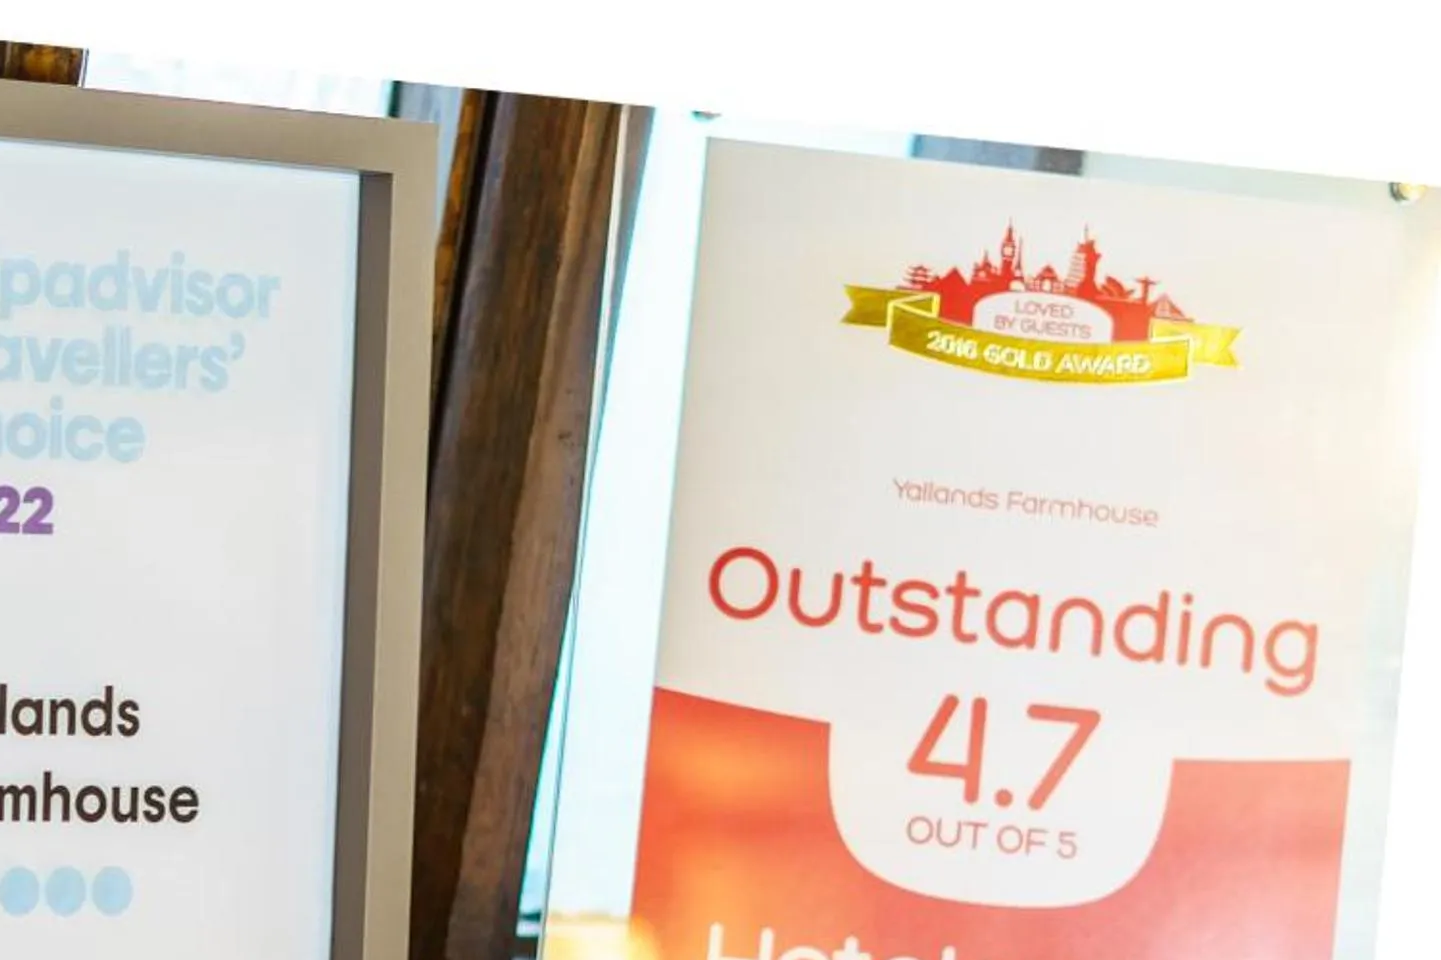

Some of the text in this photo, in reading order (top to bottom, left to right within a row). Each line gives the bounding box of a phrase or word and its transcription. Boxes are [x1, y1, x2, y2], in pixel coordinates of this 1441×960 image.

[993, 314, 1093, 340] BY GUESTS
[1013, 298, 1076, 320] LOVED
[926, 330, 1152, 378] 2016 GOLD AWARD
[893, 477, 1160, 528] Yallands Farmhouse
[708, 546, 1319, 697] Outstanding
[906, 694, 1101, 811] 4.7
[907, 816, 1079, 860] OUT OF 5
